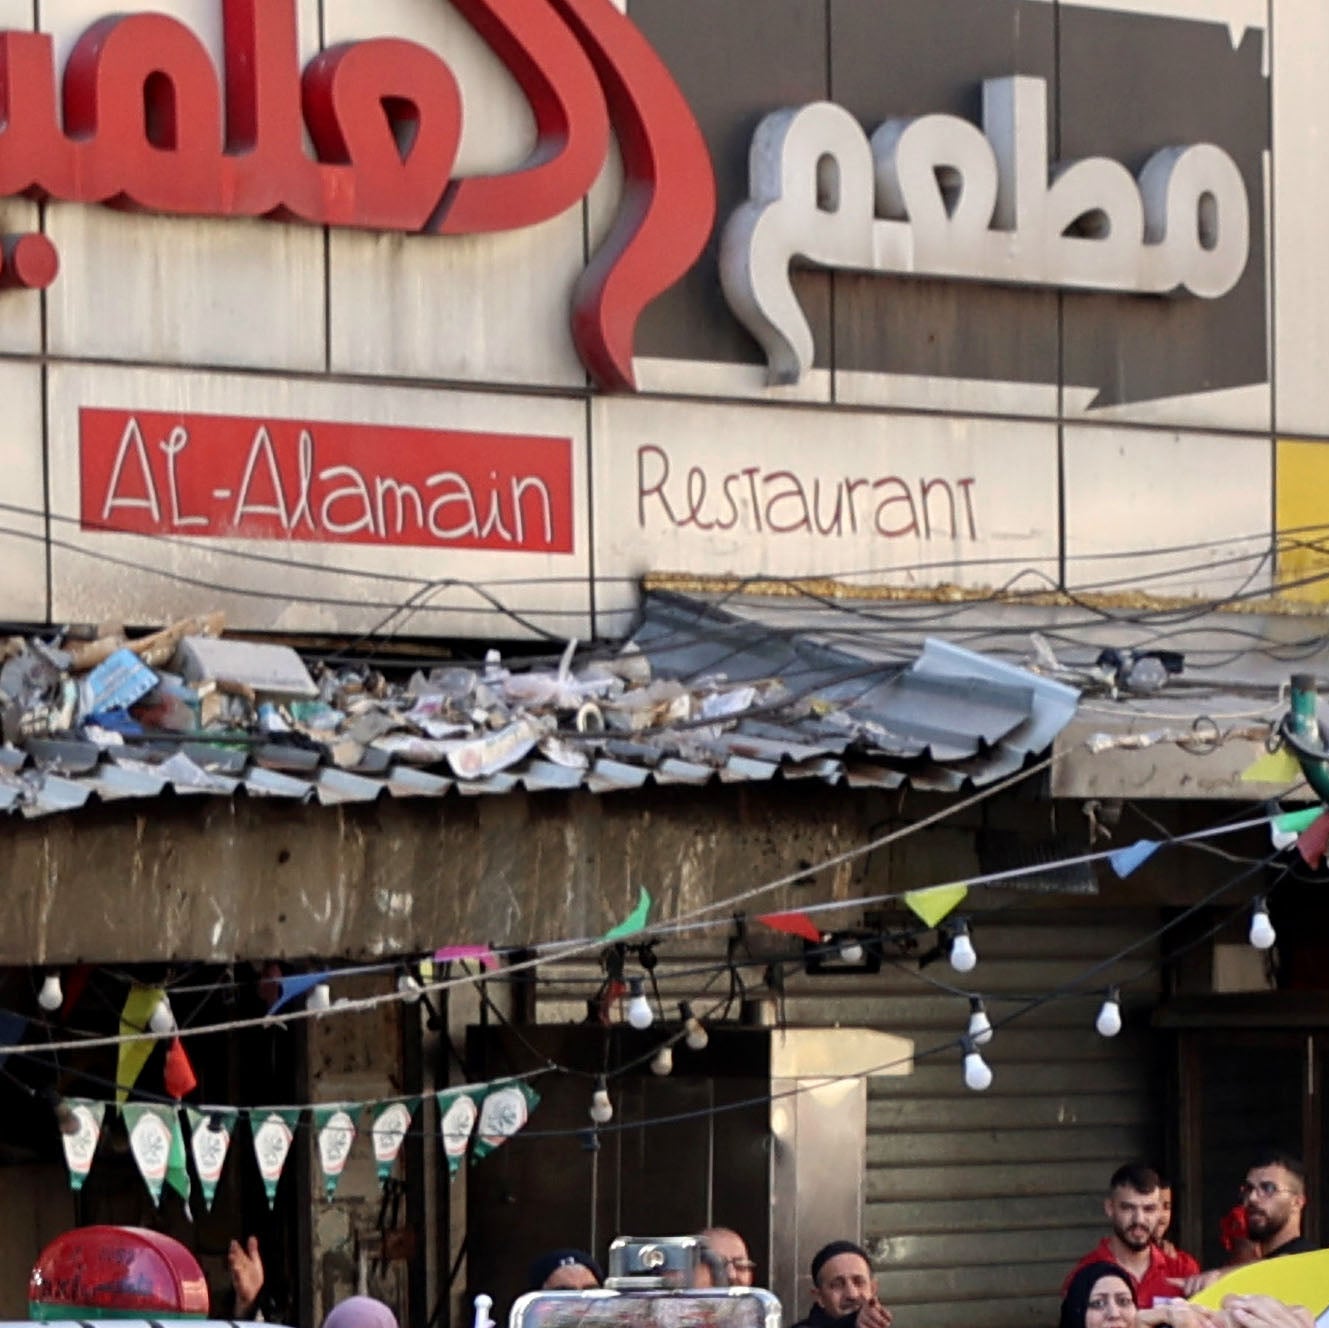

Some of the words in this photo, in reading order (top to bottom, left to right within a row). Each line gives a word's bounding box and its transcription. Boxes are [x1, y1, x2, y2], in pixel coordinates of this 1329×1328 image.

[0, 0, 716, 393] العلمي
[719, 75, 1249, 387] مطعم
[101, 415, 555, 545] AL-Alamain
[635, 443, 979, 542] Restaurant
